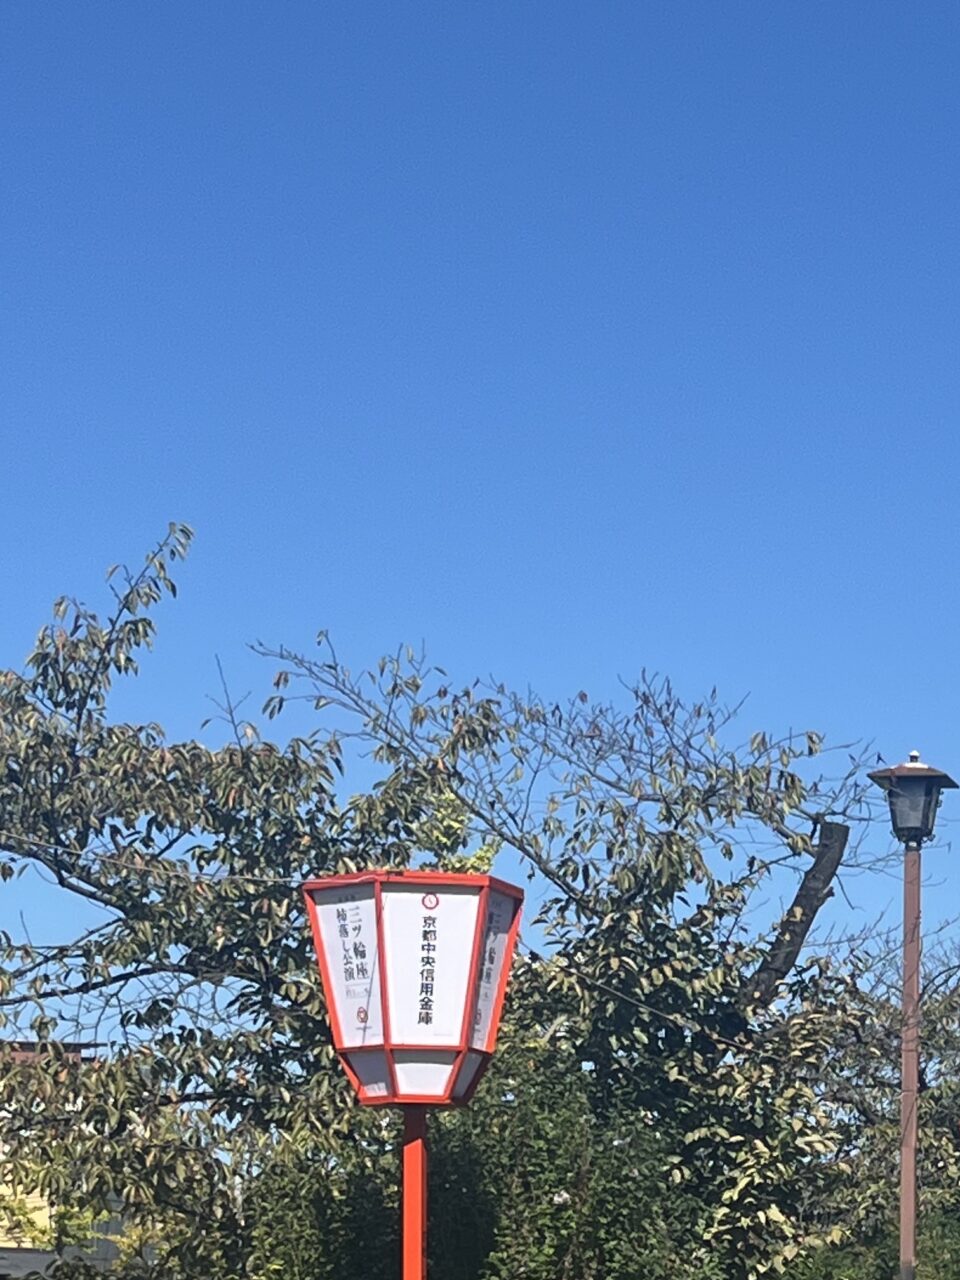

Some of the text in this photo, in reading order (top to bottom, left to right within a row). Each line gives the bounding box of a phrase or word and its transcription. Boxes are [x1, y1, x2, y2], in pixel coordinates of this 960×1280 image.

[348, 905, 370, 980] 三ツ輪座
[417, 915, 437, 1026] 京都中央信用金庫
